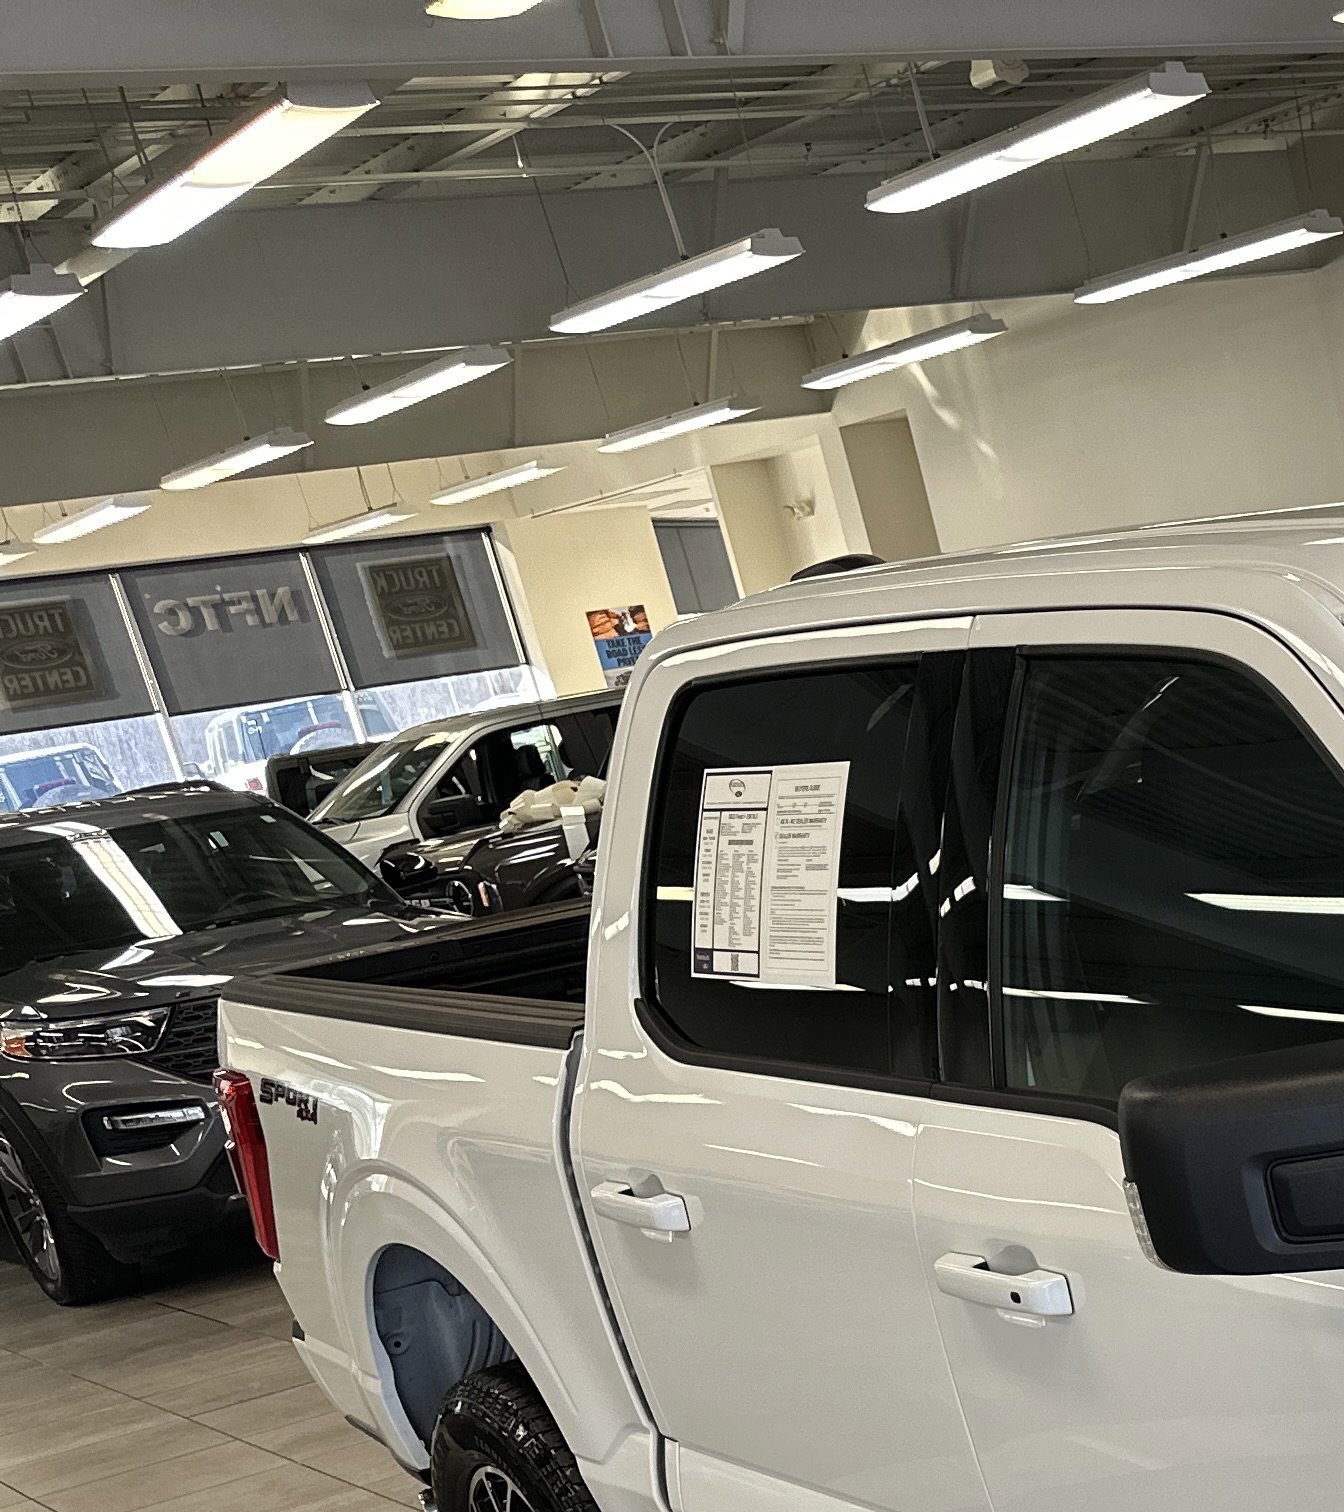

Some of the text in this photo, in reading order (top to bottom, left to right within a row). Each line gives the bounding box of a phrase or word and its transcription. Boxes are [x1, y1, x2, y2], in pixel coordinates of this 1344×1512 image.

[606, 636, 641, 648] TAKE THE
[260, 1077, 318, 1109] SPORT
